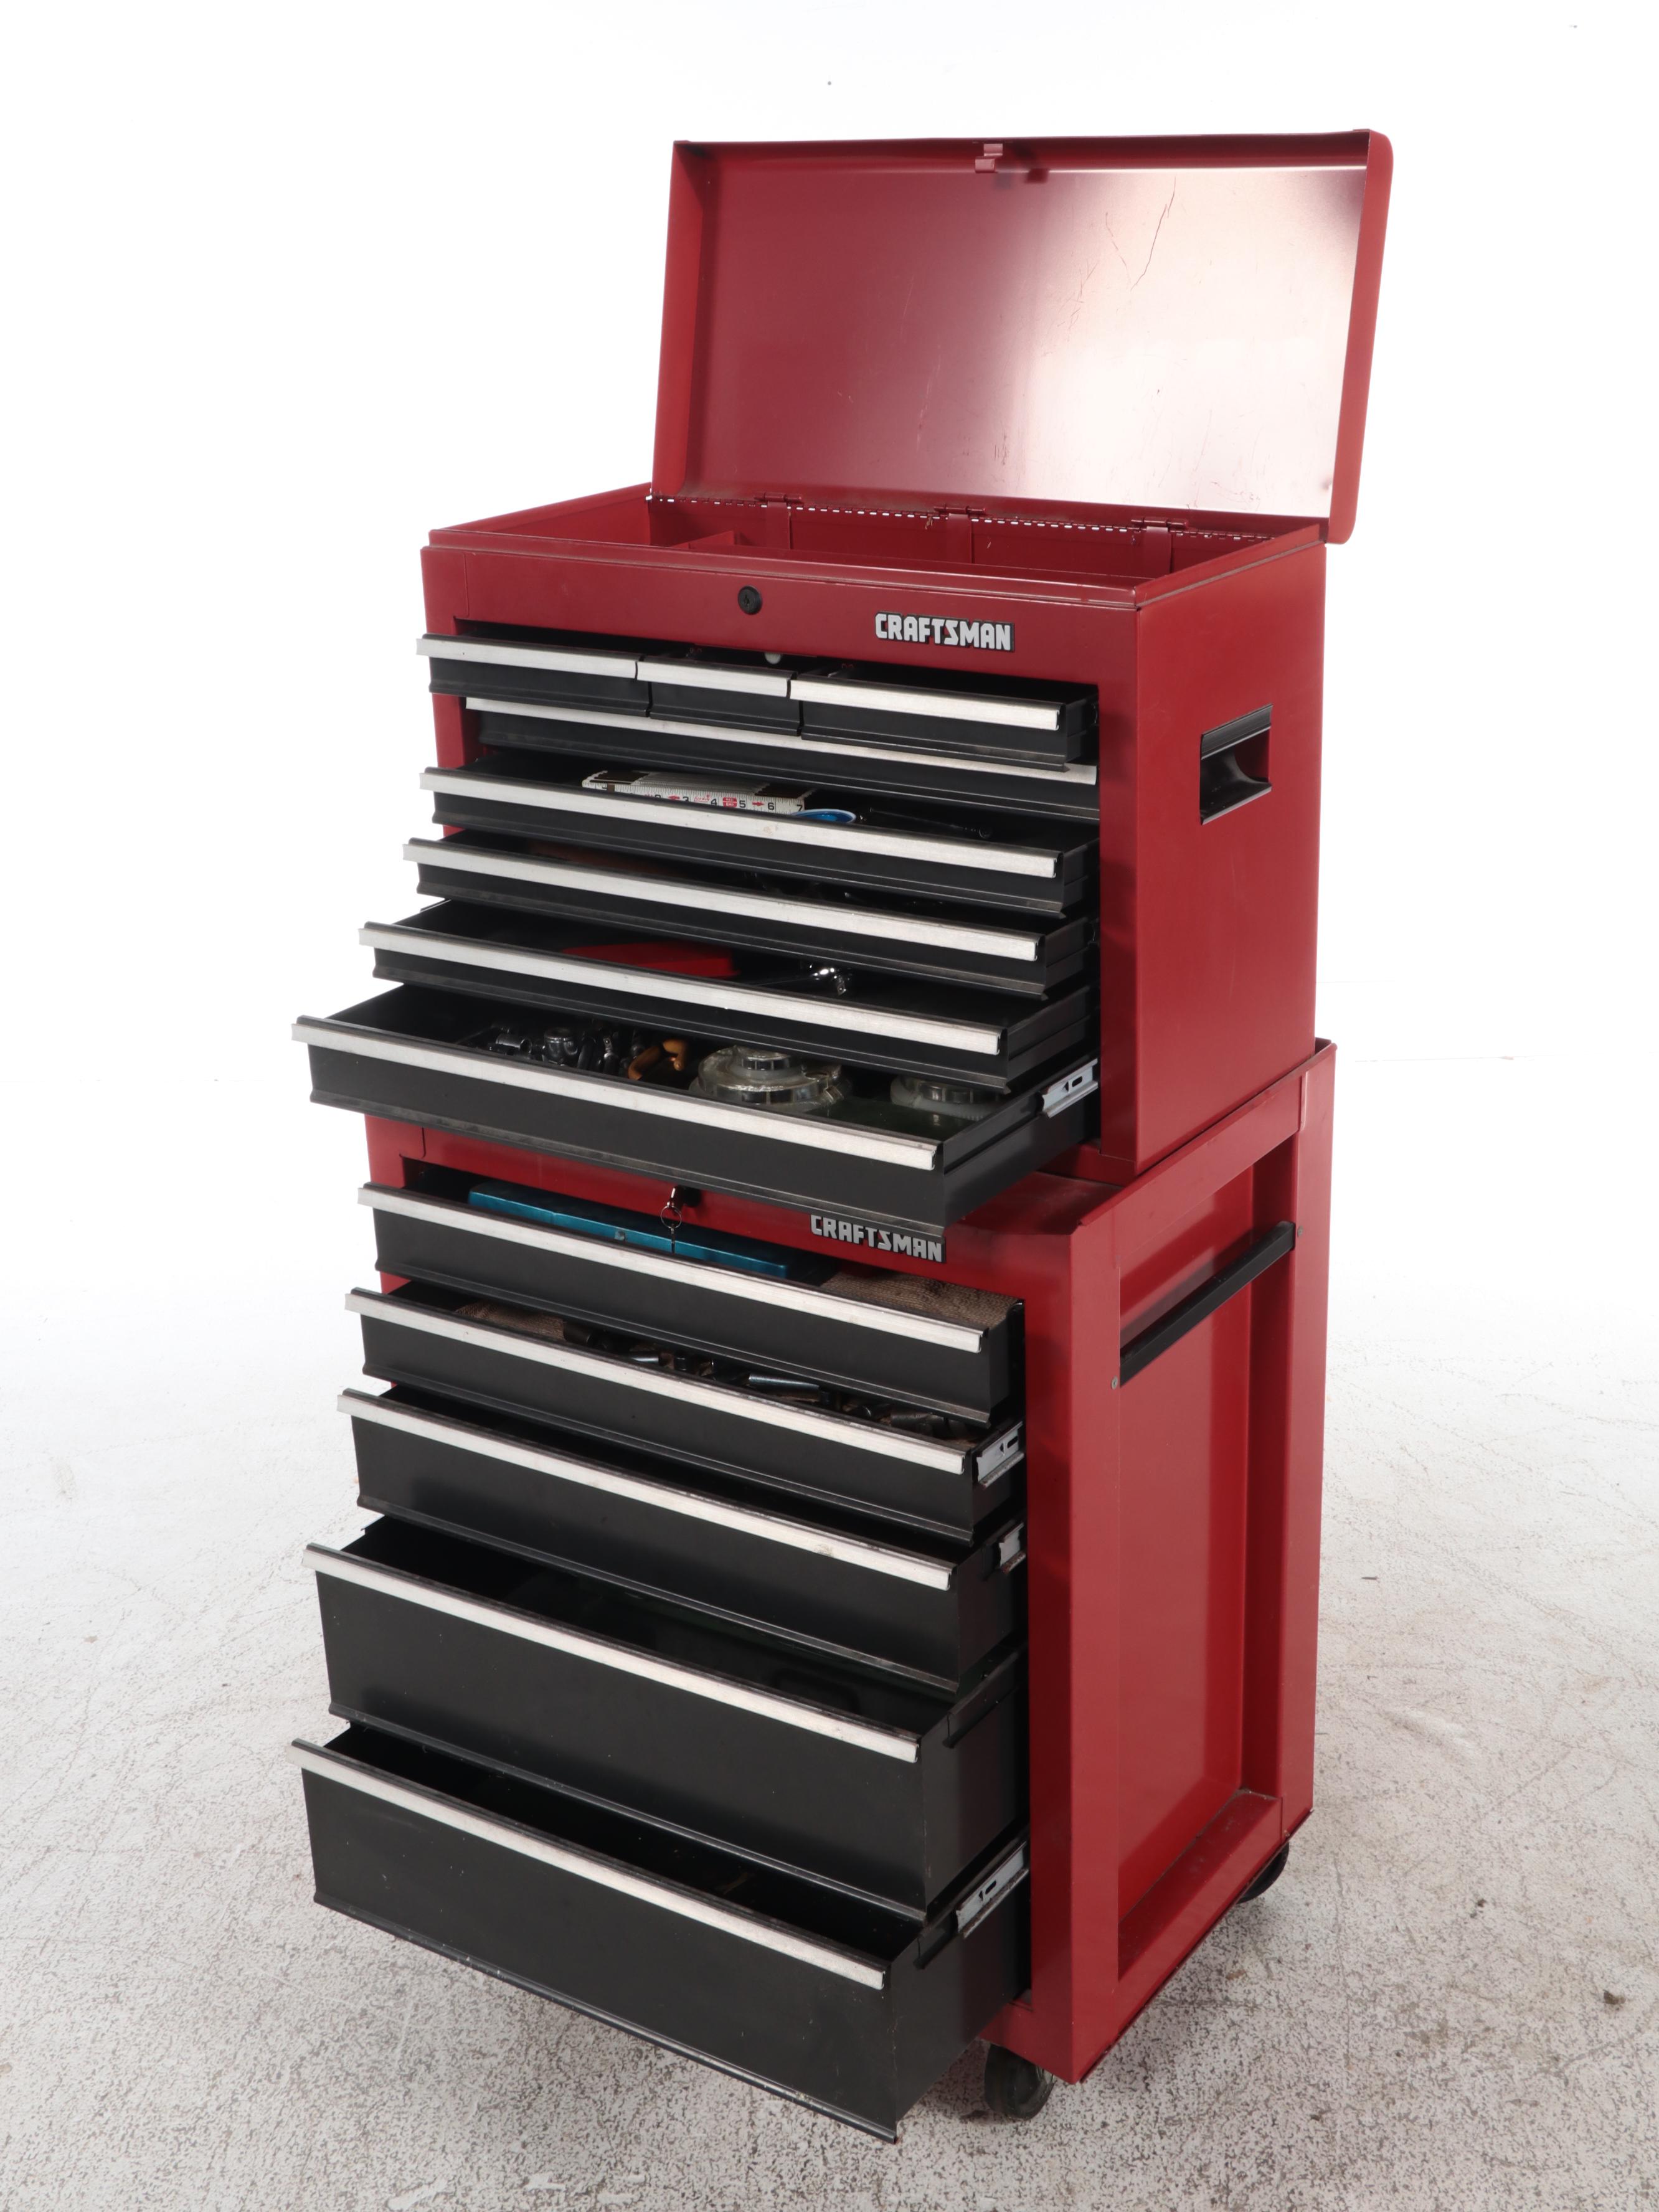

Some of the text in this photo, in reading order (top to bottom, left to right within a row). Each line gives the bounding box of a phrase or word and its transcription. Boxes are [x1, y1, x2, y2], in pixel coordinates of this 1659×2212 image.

[874, 613, 1012, 651] CRAFTSMAN
[739, 800, 746, 808] 5
[767, 802, 775, 810] 6
[810, 1214, 942, 1263] CRAFTSMAN
